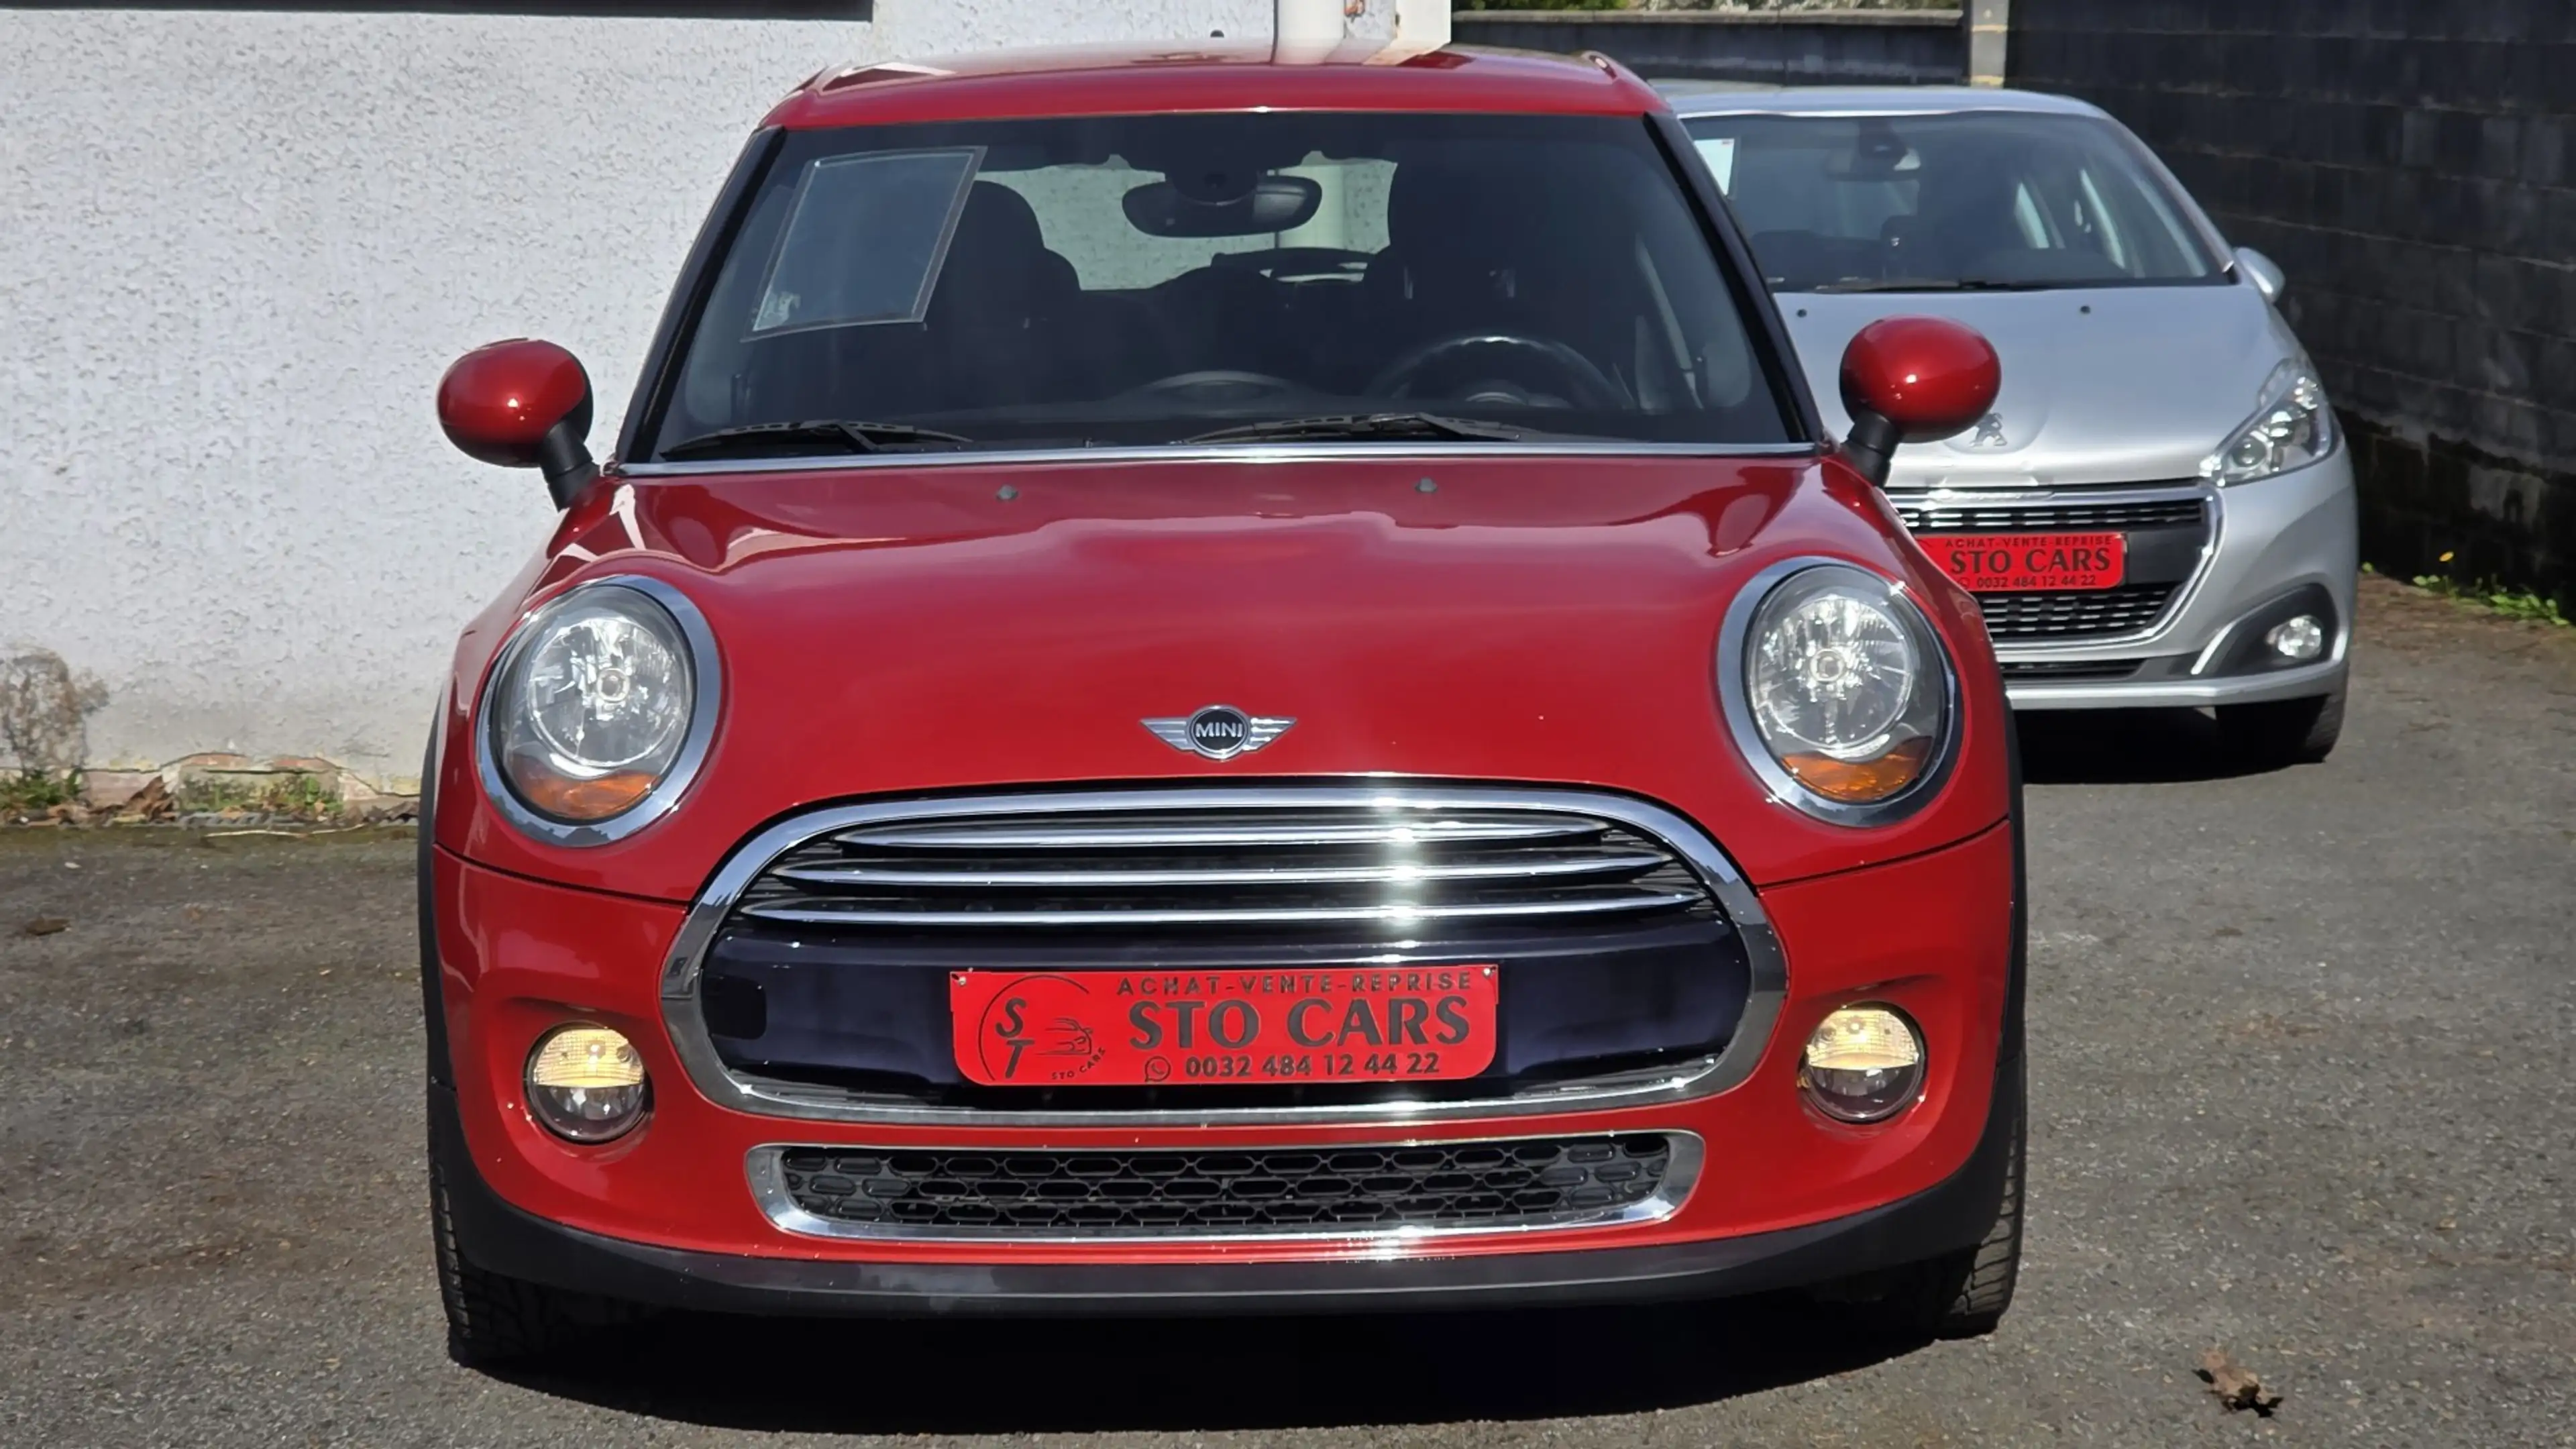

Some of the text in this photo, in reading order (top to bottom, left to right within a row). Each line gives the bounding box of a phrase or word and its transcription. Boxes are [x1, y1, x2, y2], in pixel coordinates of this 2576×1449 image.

[1950, 547, 2110, 574] STO CARS
[1977, 574, 2096, 588] 0032 484 12 44 22
[1195, 722, 1242, 738] MINI
[995, 998, 1026, 1038] S
[1128, 996, 1470, 1050] STO CARS
[1006, 1038, 1035, 1078] T
[1185, 1052, 1440, 1077] 0032 484 12 44 22
[1051, 1071, 1075, 1080] STO
